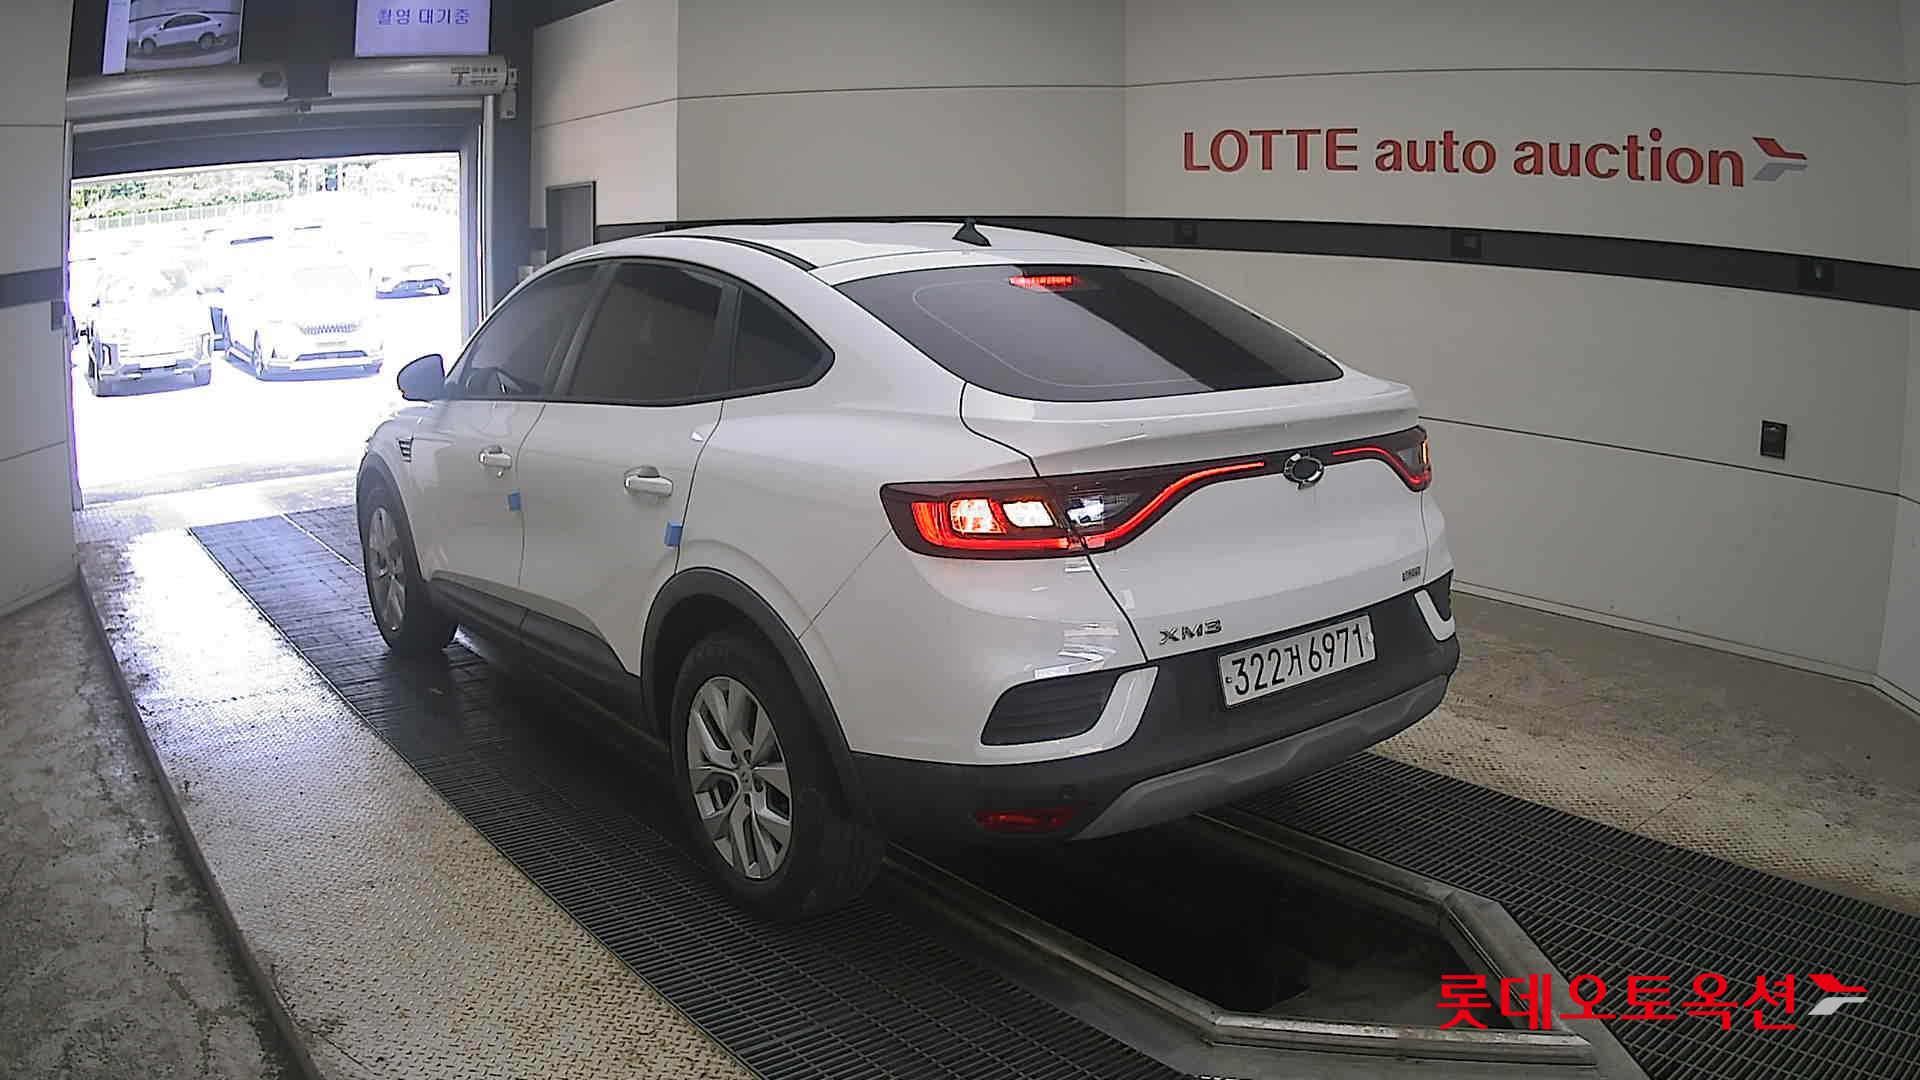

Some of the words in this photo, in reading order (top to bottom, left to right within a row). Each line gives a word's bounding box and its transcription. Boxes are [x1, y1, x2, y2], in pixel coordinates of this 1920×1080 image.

[418, 8, 470, 25] 대기중
[1183, 127, 1358, 172] LOTTE
[1375, 130, 1497, 174] auto
[1513, 127, 1745, 187] auction
[1159, 619, 1222, 646] XM3
